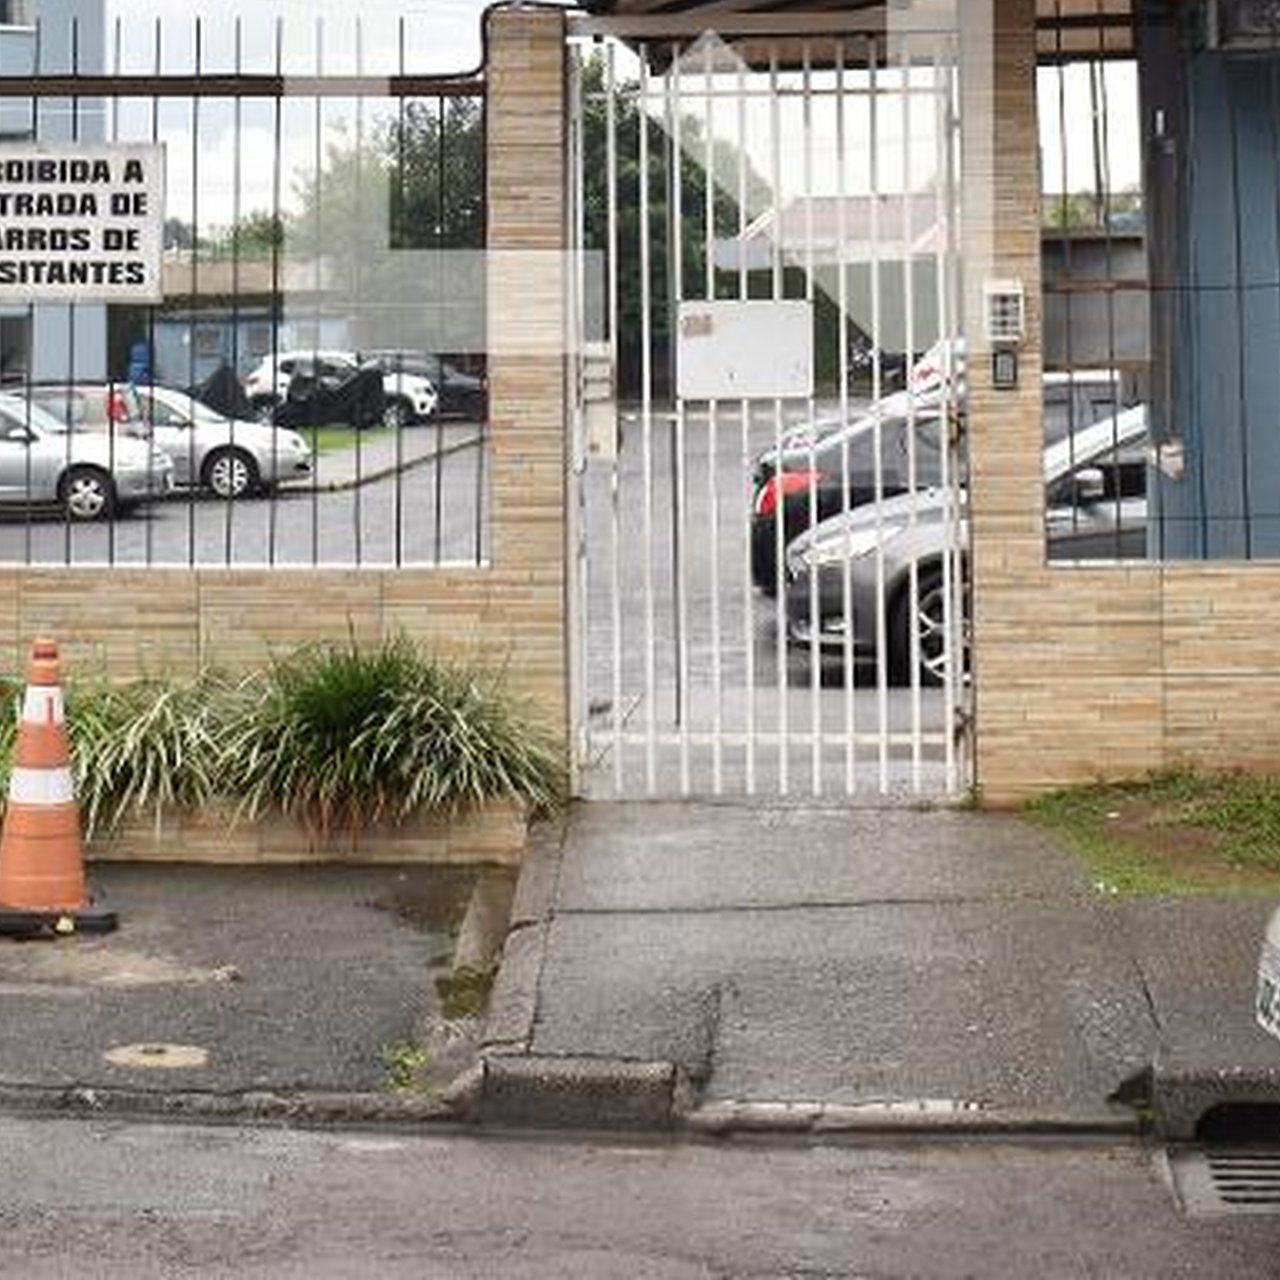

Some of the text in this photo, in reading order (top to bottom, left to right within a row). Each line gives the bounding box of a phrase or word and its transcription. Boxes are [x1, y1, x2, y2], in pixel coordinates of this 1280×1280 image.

[123, 160, 144, 184] A
[110, 192, 148, 216] DE
[103, 228, 140, 252] DE
